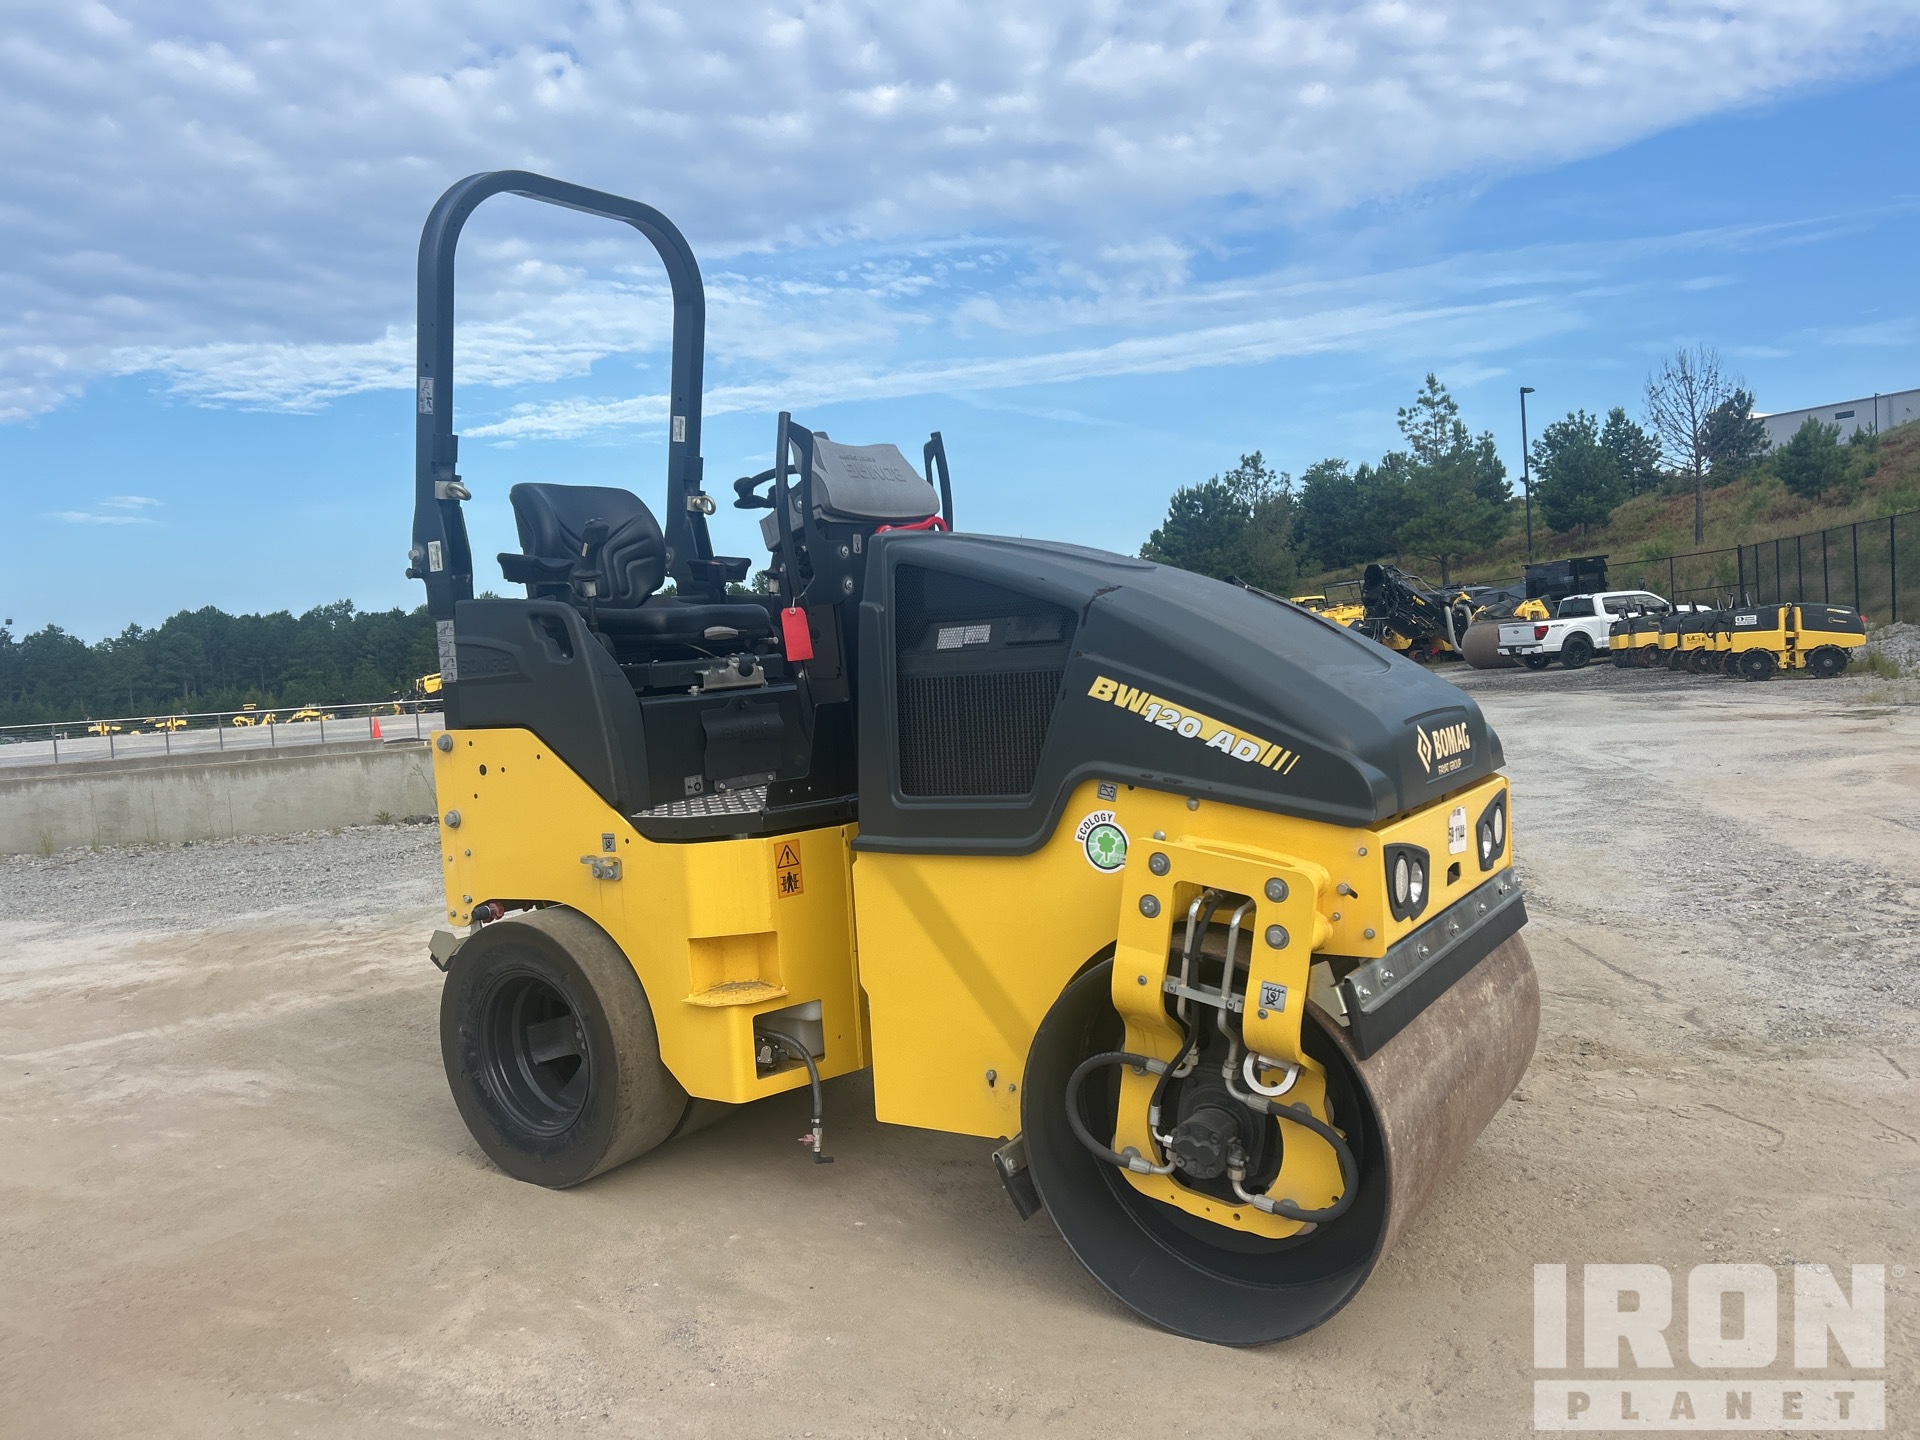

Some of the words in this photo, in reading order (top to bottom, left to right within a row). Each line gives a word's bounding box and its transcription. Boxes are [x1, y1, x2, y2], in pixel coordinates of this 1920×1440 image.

[1205, 730, 1261, 763] AD
[1431, 721, 1471, 760] BOMAG
[1077, 812, 1113, 841] ECOLOGY
